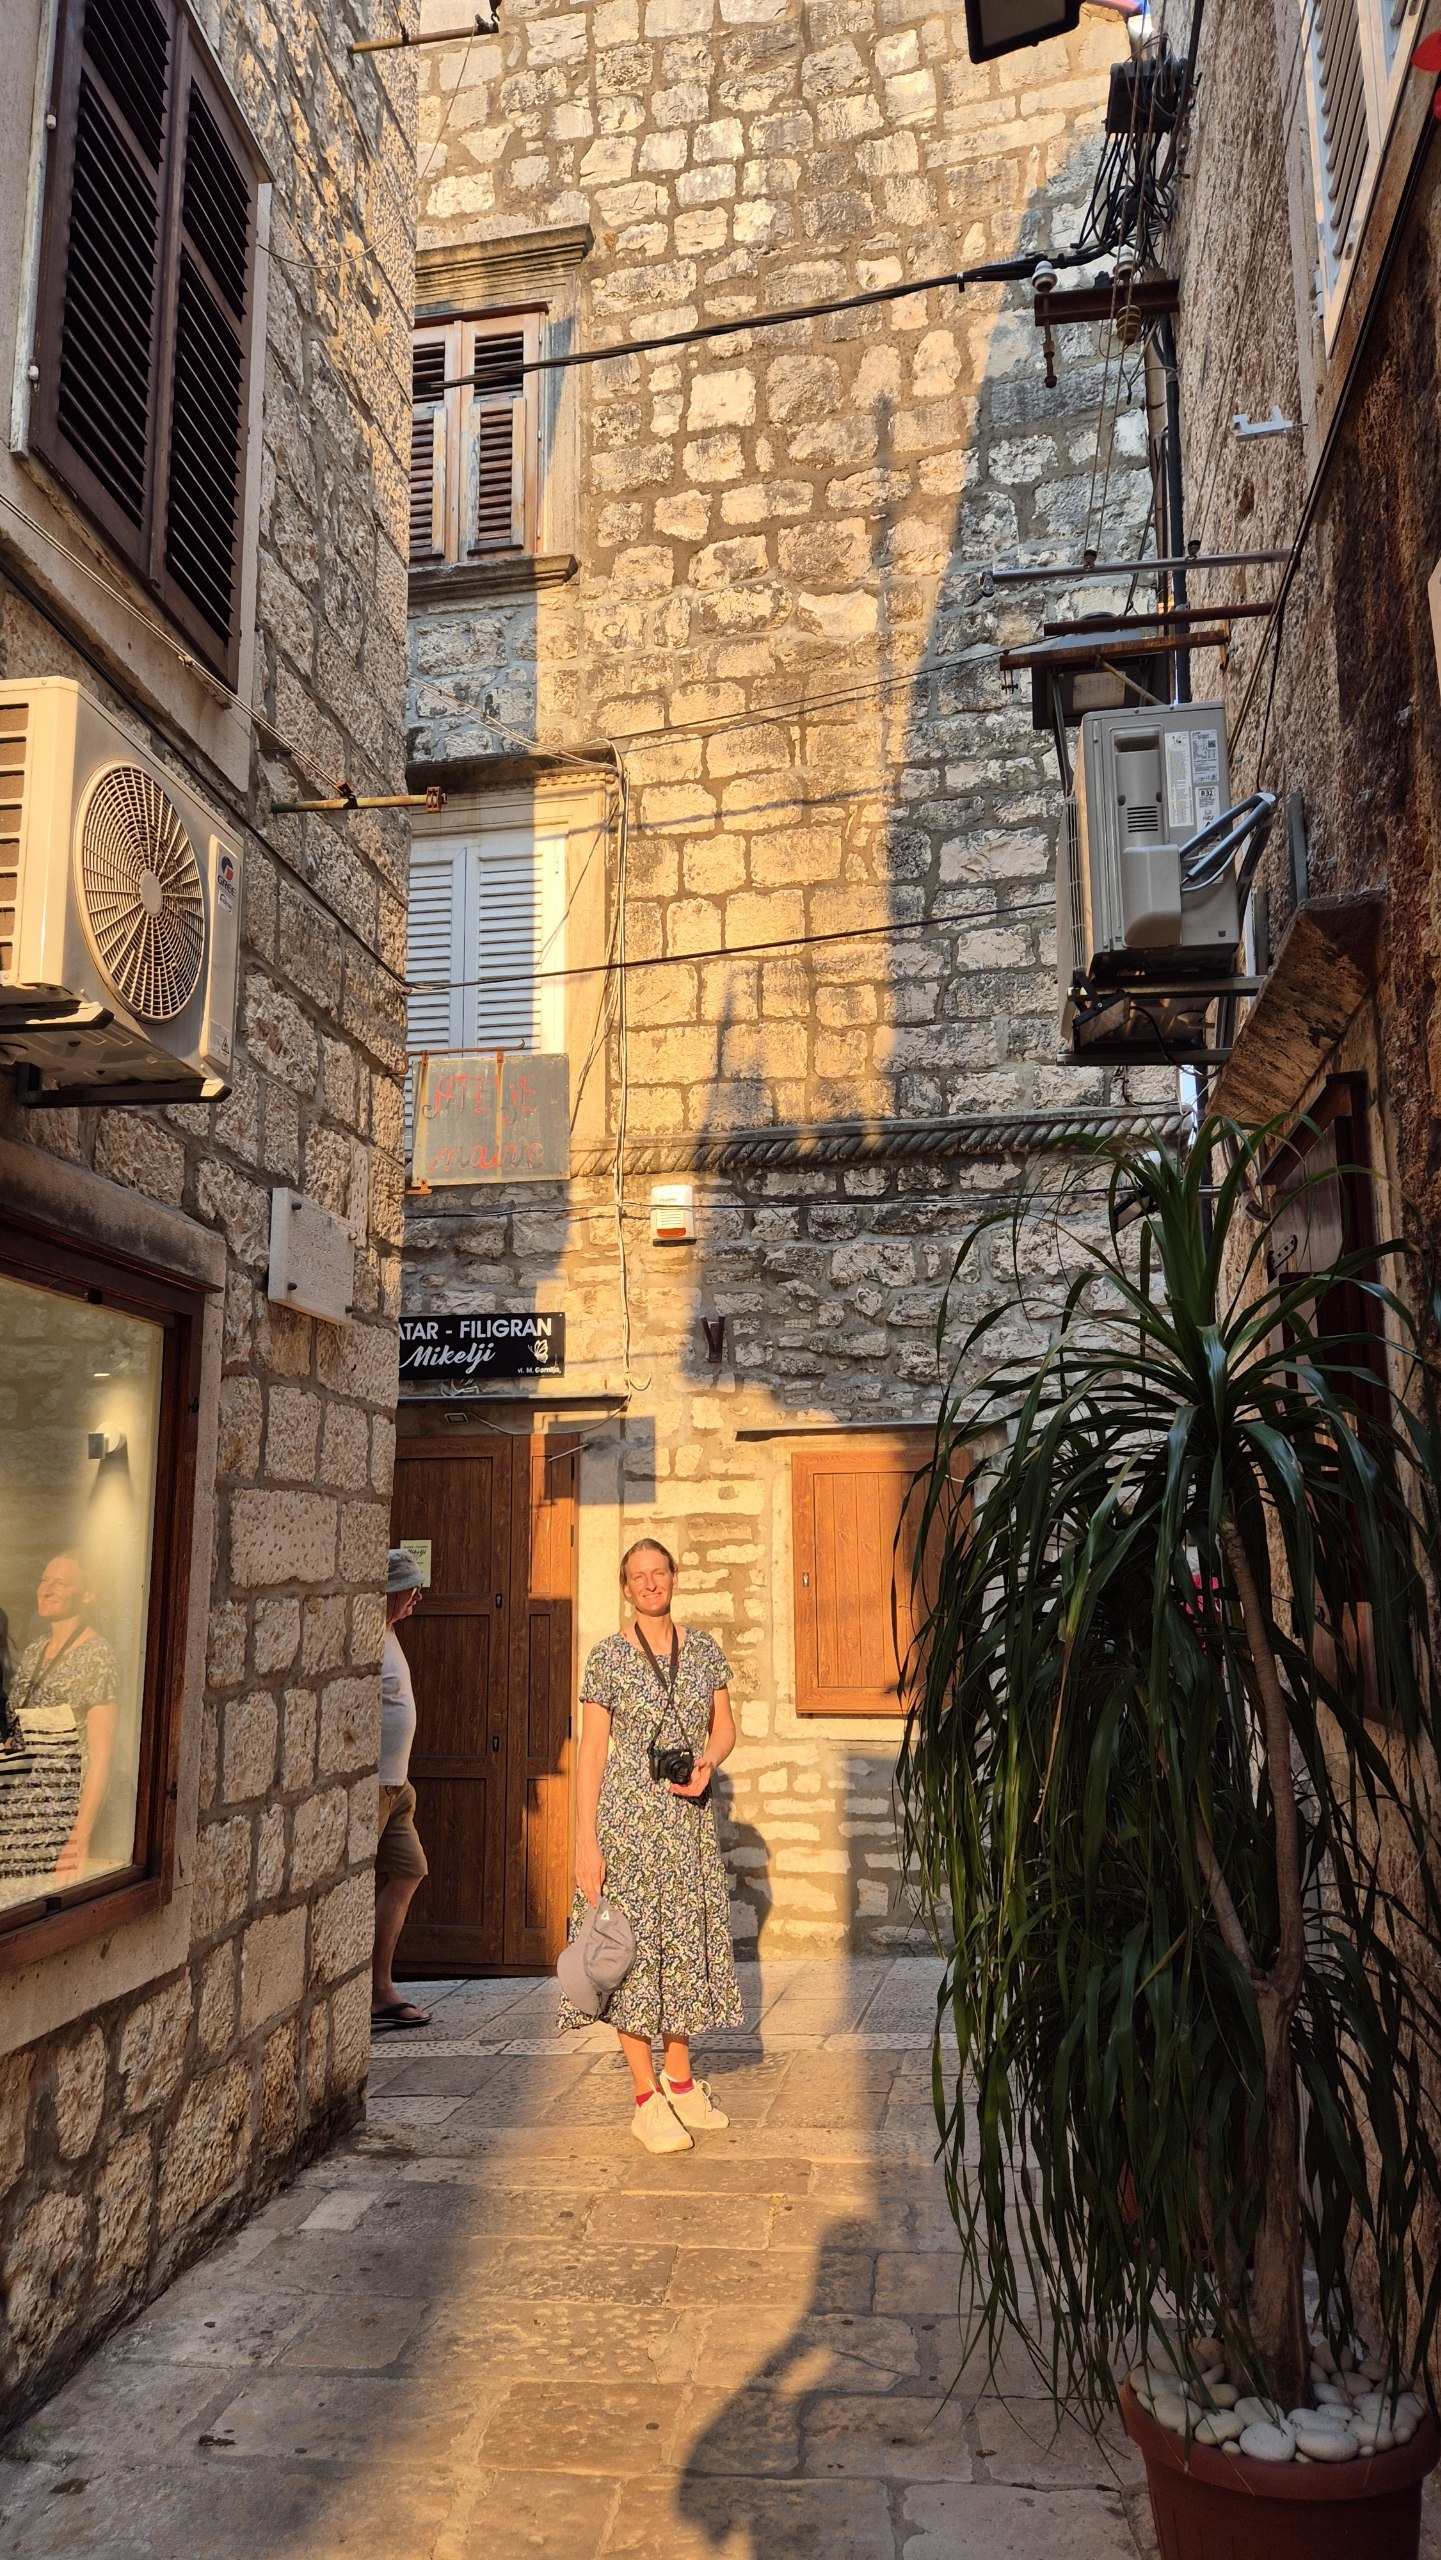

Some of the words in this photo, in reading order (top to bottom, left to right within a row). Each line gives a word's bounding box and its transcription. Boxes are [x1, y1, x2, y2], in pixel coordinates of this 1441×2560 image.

[218, 874, 236, 897] GREE
[459, 1317, 552, 1339] FILIGRAN
[398, 1342, 496, 1375] Mikelji
